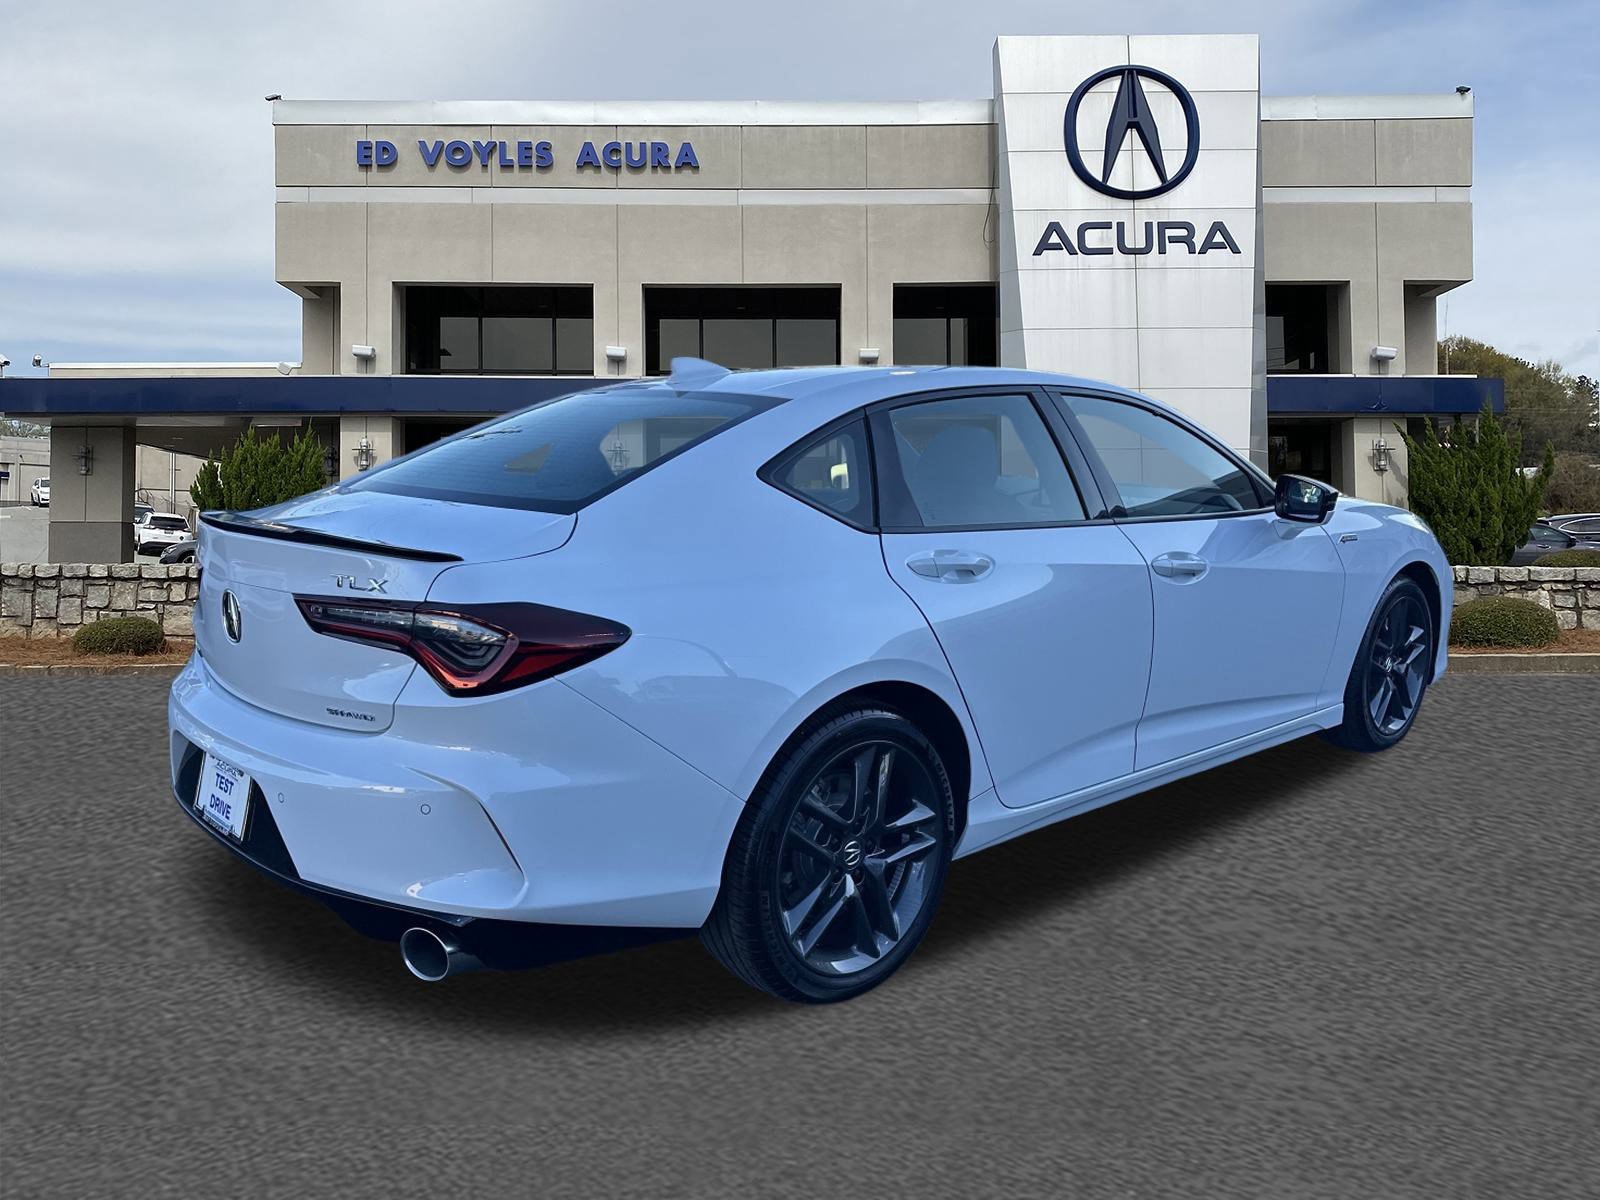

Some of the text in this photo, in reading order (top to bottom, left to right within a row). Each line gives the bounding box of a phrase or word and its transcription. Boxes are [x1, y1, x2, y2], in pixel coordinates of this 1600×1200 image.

[357, 140, 700, 167] ED VOYLES ACURA
[1032, 221, 1242, 256] ACURA
[329, 573, 388, 594] TLX
[215, 773, 234, 796] TEST
[209, 794, 231, 820] DRIVE
